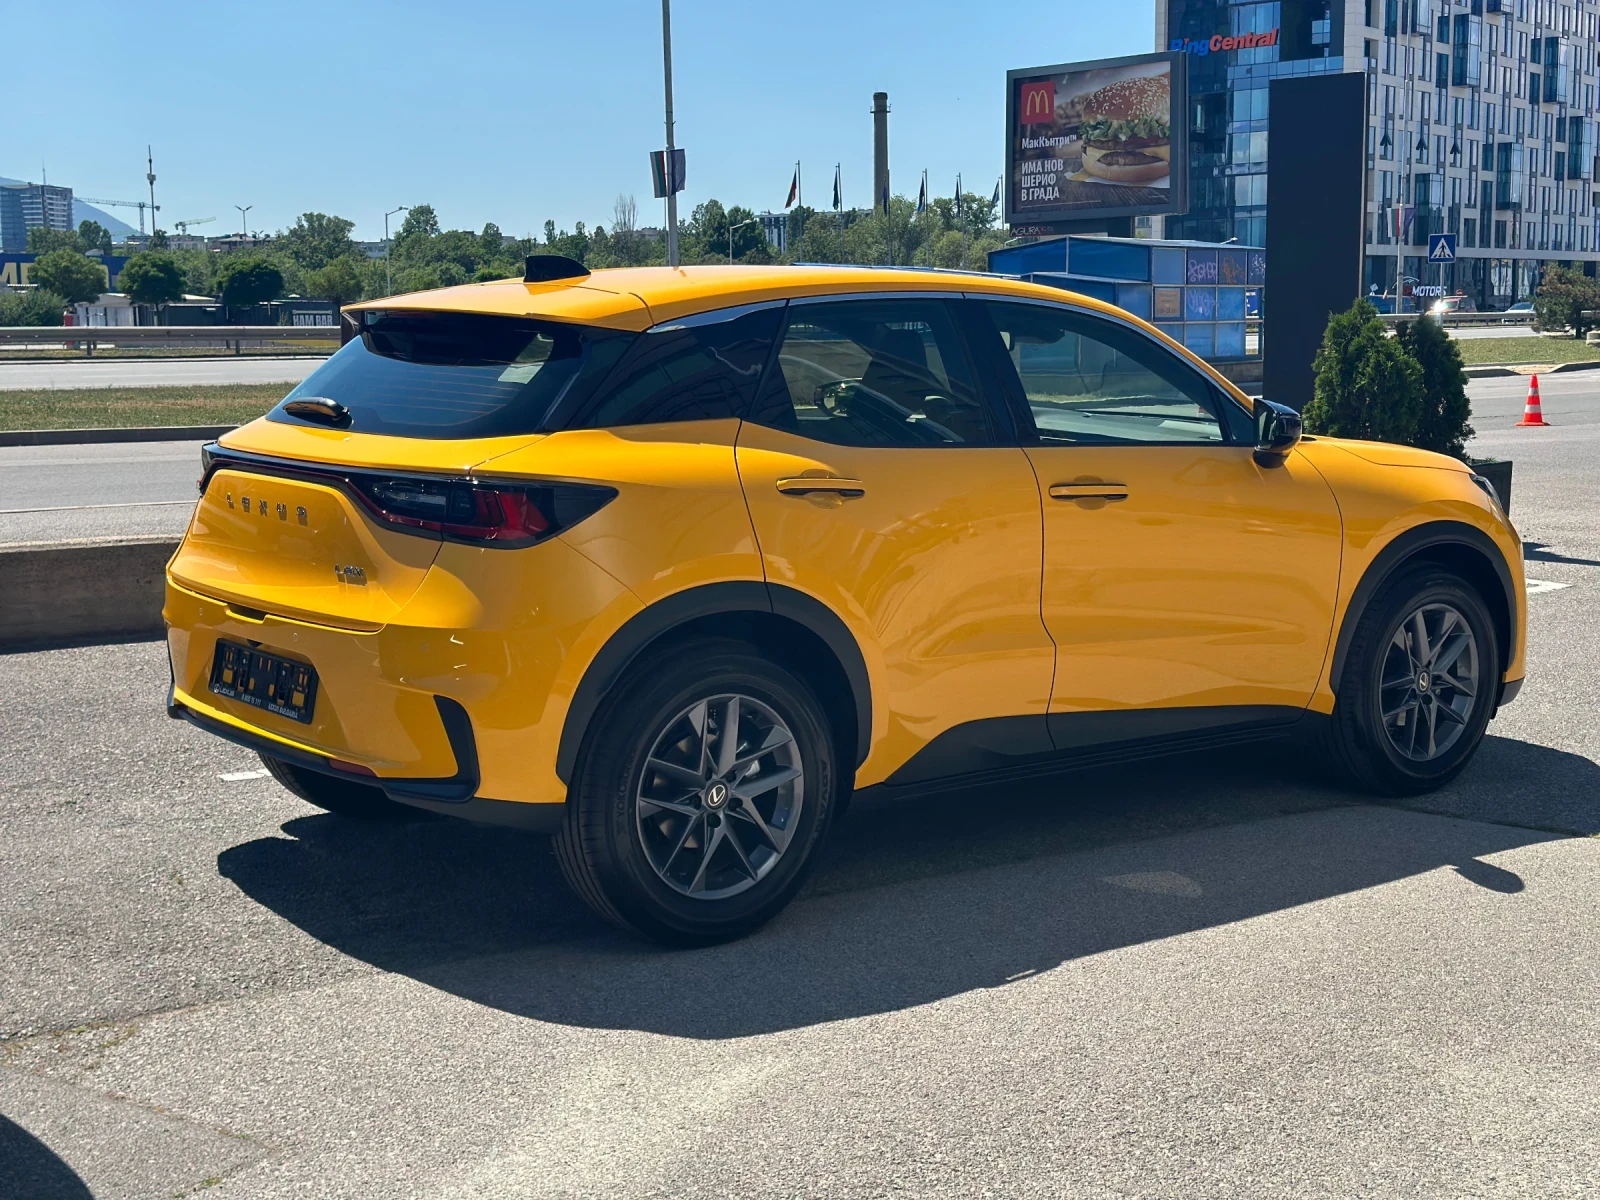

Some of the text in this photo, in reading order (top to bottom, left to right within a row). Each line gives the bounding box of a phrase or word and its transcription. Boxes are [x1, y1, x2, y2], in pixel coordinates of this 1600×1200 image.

[1021, 158, 1064, 175] ИМА НОВ
[1021, 172, 1057, 188] ШЕРИФ
[1021, 186, 1060, 202] В ГРАДА
[226, 492, 306, 517] LEXUS
